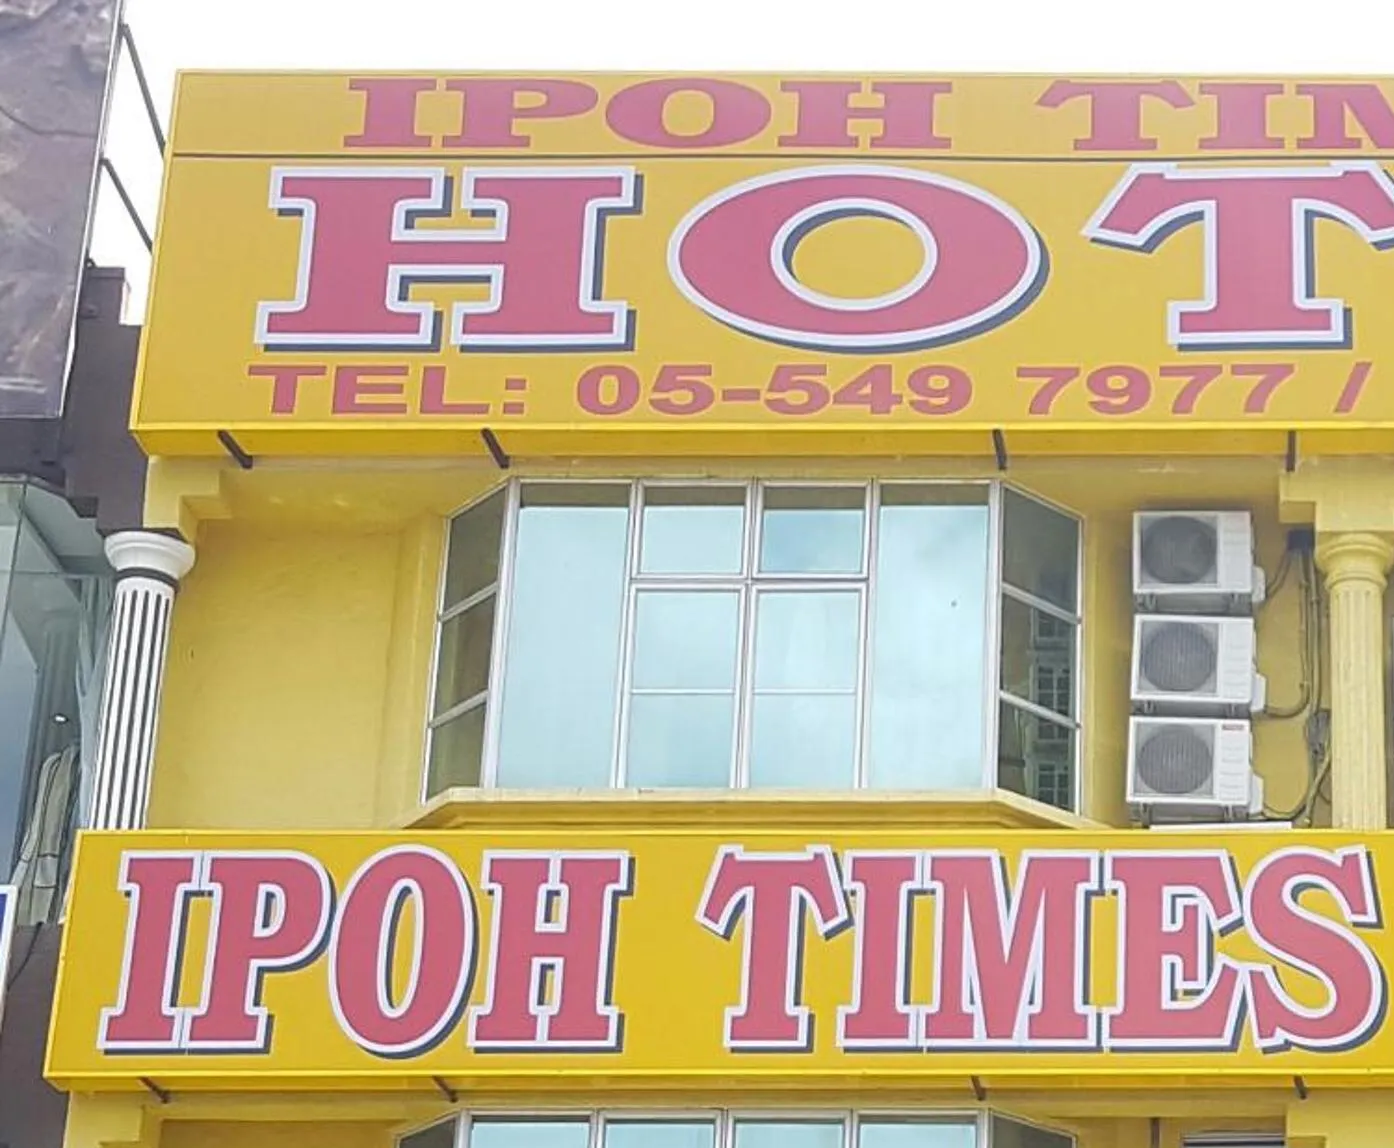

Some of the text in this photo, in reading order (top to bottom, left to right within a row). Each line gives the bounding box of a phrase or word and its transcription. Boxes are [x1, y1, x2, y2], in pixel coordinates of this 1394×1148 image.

[342, 77, 953, 149] IPOH
[247, 363, 530, 416] TEL:
[575, 363, 974, 416] 05-549
[1015, 362, 1296, 415] 7977
[1332, 361, 1374, 415] /
[96, 843, 637, 1059] IPOH
[693, 844, 1390, 1055] TIMES
